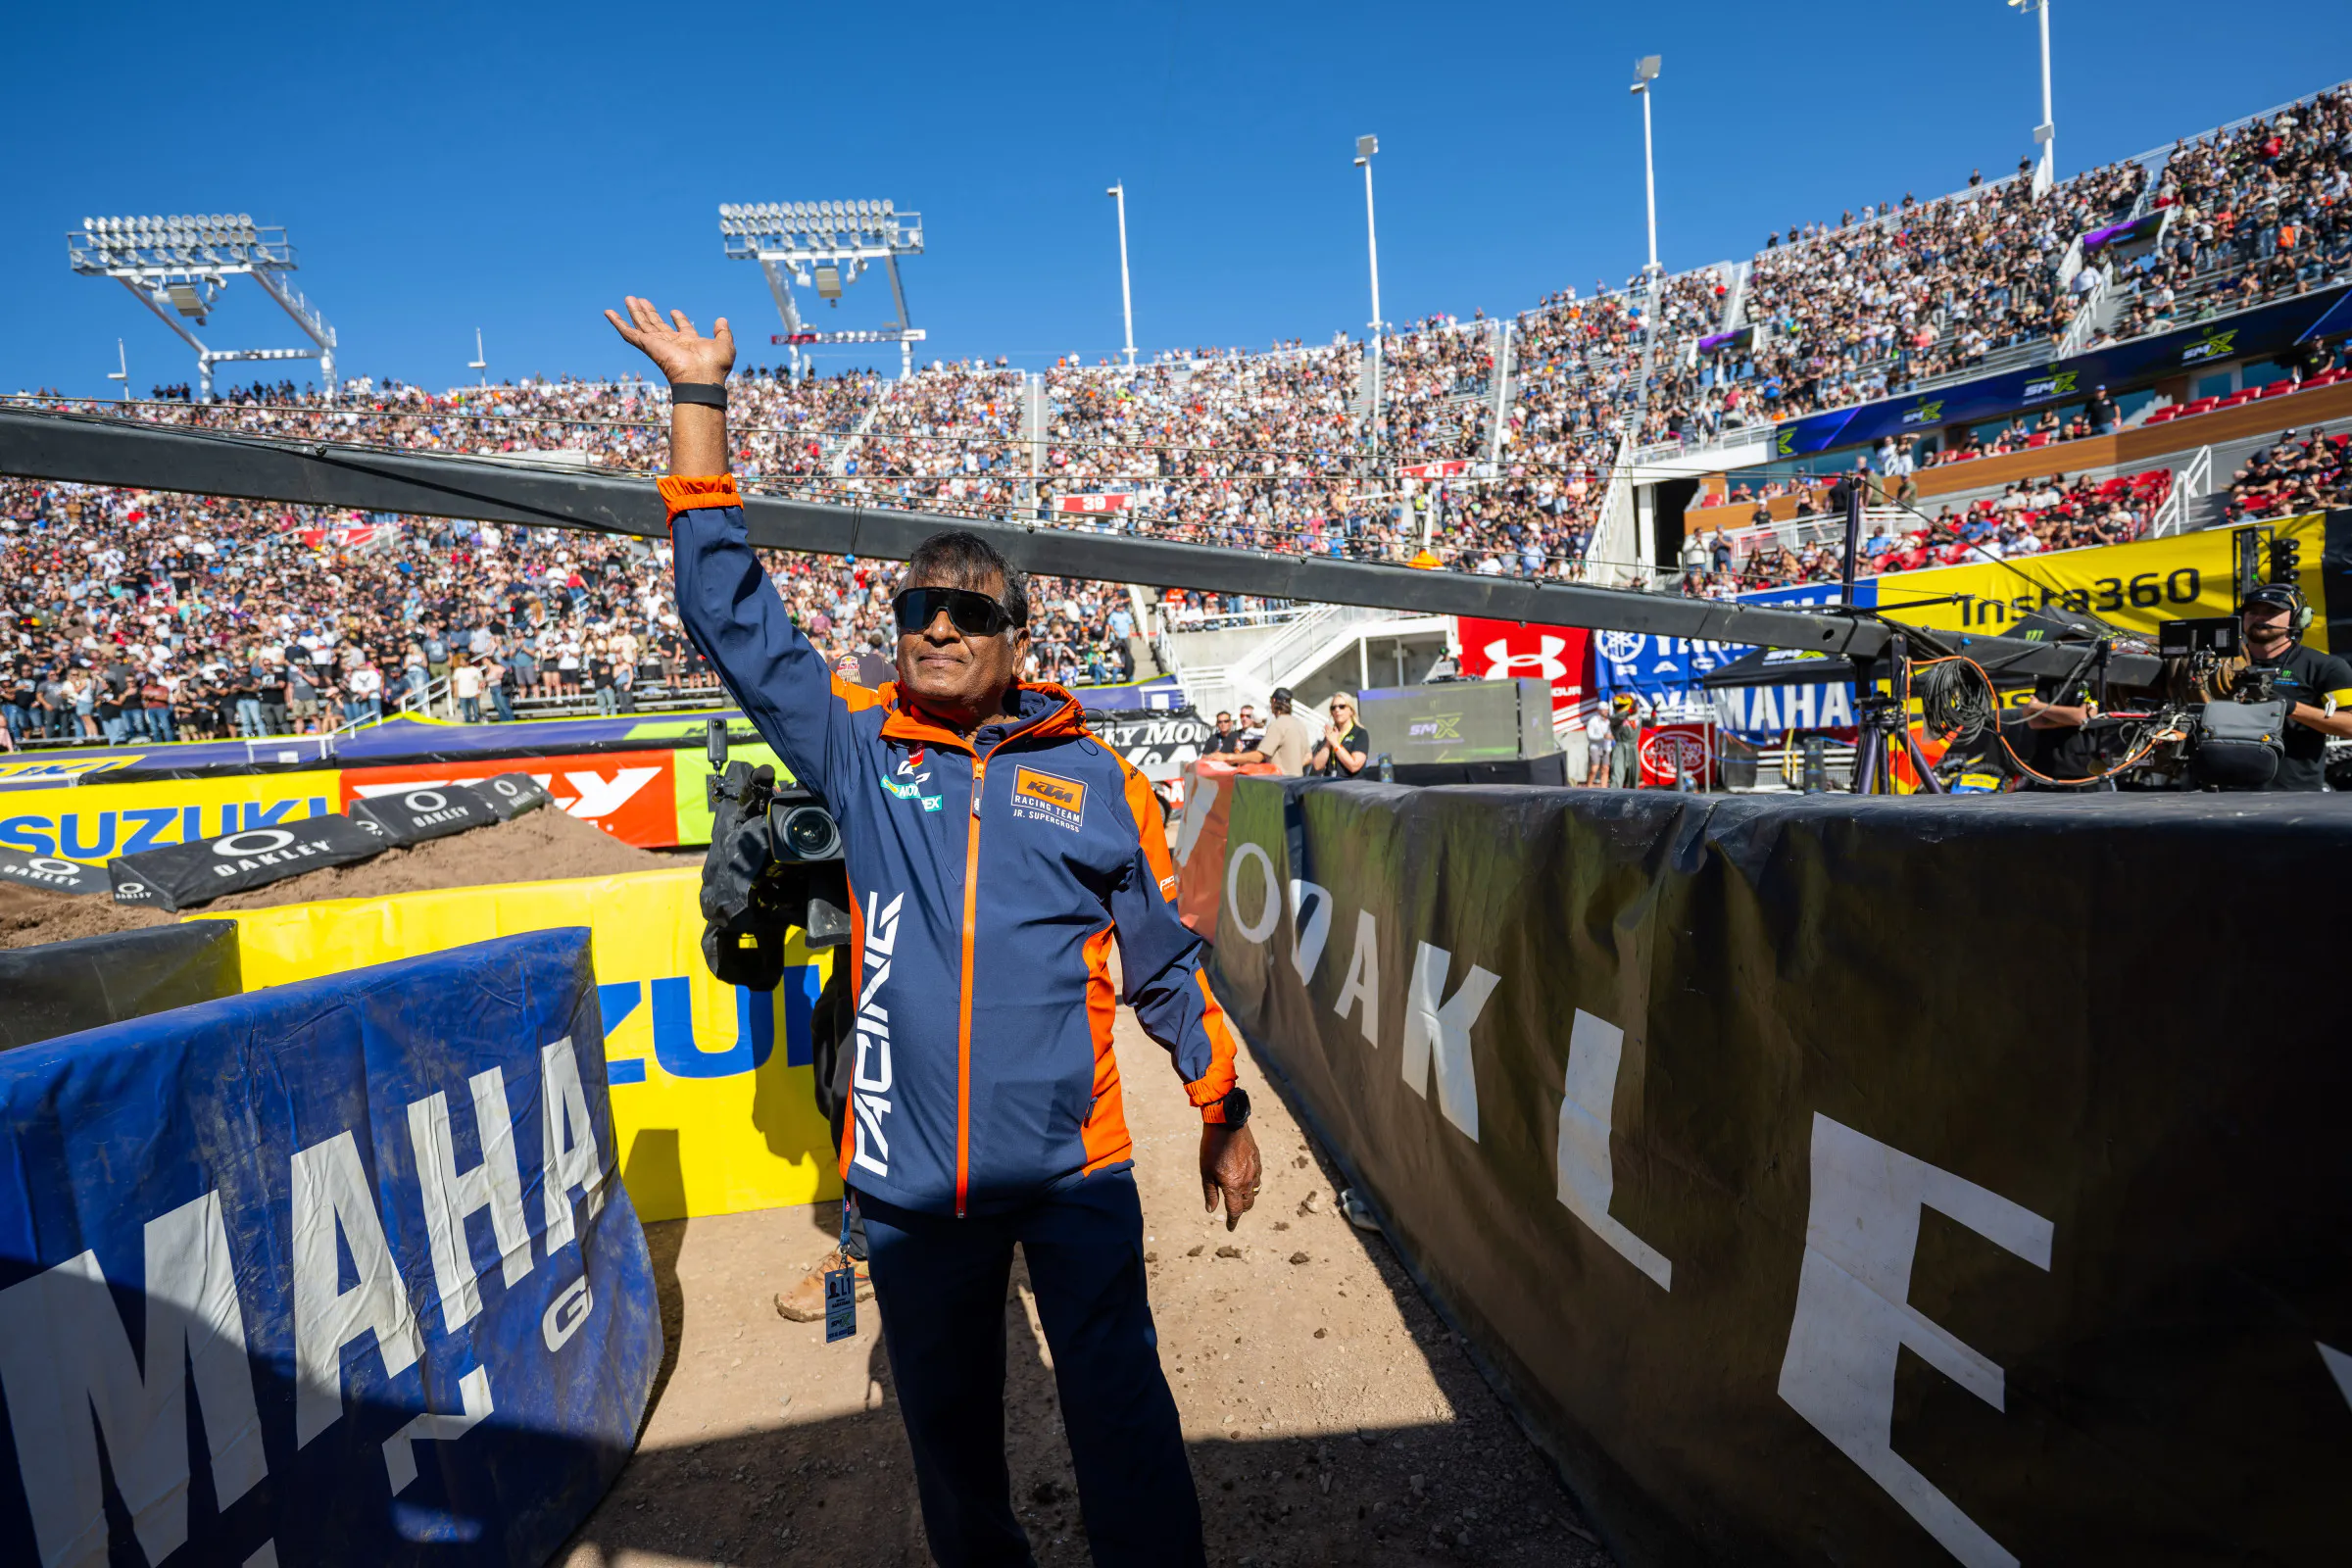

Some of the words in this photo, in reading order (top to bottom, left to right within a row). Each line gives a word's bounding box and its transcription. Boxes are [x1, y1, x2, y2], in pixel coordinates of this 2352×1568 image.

[1082, 497, 1106, 511] 39
[1550, 685, 1582, 697] OUR
[1409, 717, 1460, 739] SMX
[1027, 781, 1074, 803] KTM
[411, 806, 469, 828] OAKLEY
[1014, 795, 1052, 811] RACING
[1055, 807, 1080, 823] TEAM
[1013, 808, 1026, 818] JR.
[1028, 810, 1080, 833] SUPERCROSS
[213, 839, 331, 877] OAKLEY
[3, 864, 81, 886] OAKLEY
[115, 891, 152, 900] OAKLEY
[854, 891, 905, 1179] RACING
[1289, 877, 2352, 1568] OAKLE
[840, 1277, 852, 1296] L1
